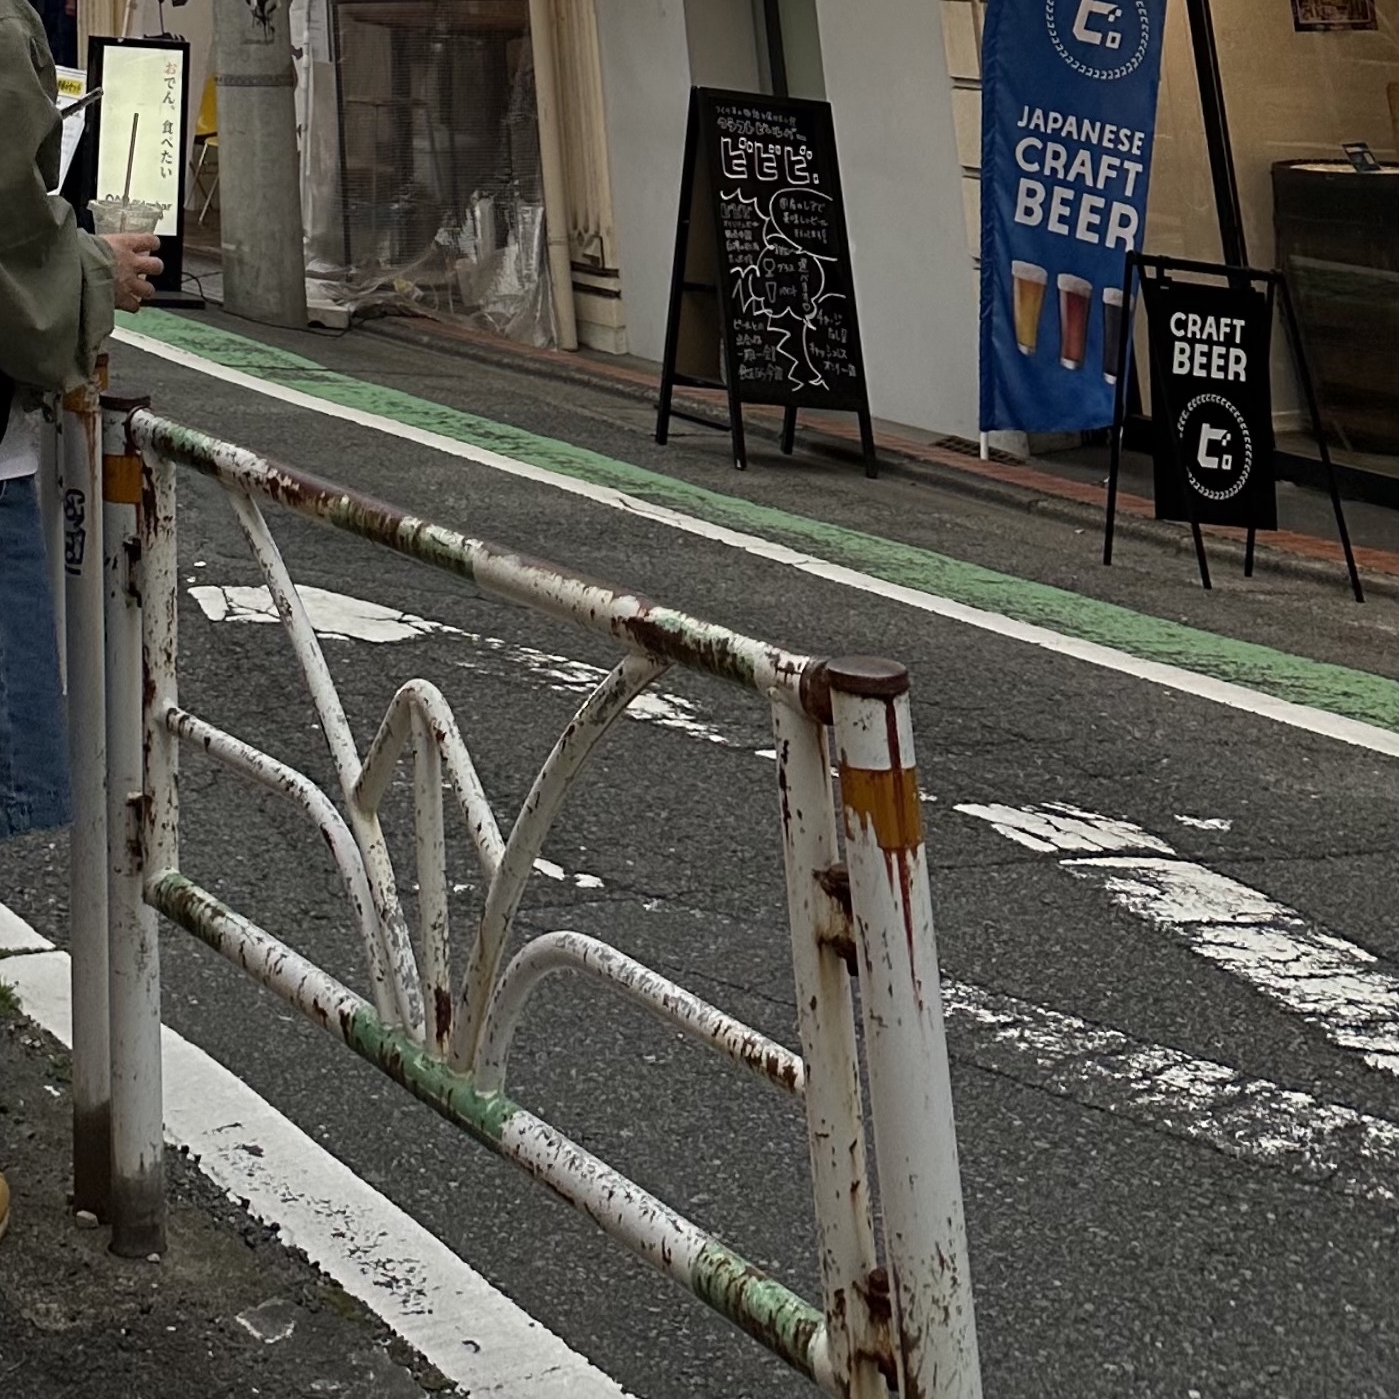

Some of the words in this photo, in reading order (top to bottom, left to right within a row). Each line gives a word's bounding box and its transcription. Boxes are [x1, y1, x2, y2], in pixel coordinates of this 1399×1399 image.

[1017, 105, 1144, 156] JAPANESE
[1015, 137, 1143, 198] CRAFT
[1014, 178, 1139, 252] BEER
[1170, 311, 1246, 344] CRAFT
[1172, 341, 1248, 382] BEER
